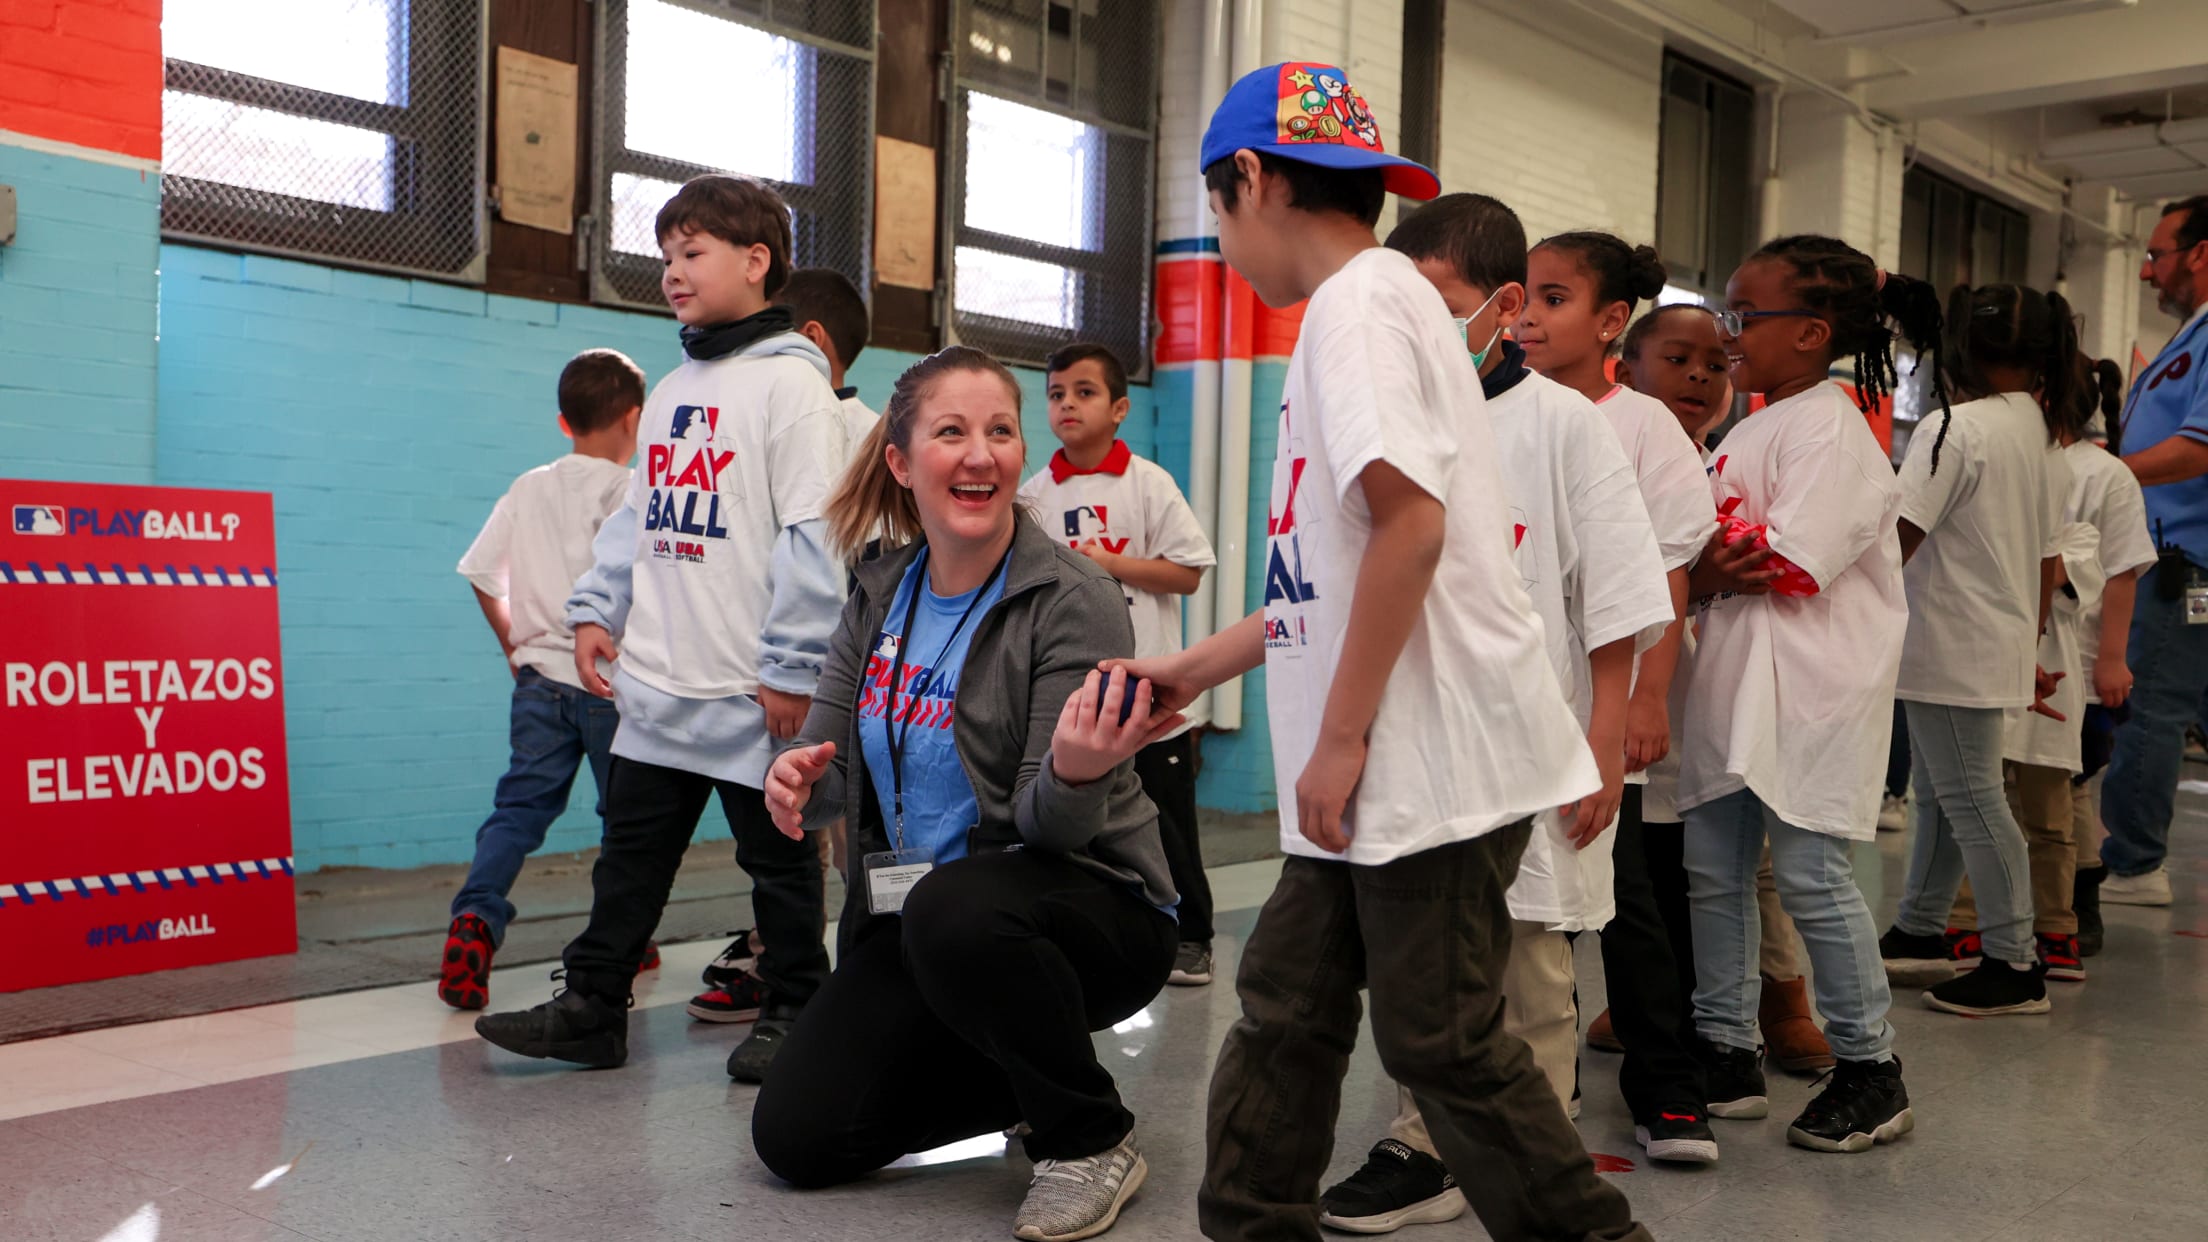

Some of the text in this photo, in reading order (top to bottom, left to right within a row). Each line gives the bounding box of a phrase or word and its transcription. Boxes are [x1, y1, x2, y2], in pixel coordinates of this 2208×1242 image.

[647, 443, 736, 492] PLAY
[645, 488, 727, 539] BALL
[675, 541, 704, 557] USA
[5, 658, 275, 707] ROLETAZOS
[866, 655, 955, 699] PLYBAL
[135, 706, 164, 748] Y
[27, 748, 266, 803] ELEVADOS
[86, 914, 215, 947] #PLAYBALL
